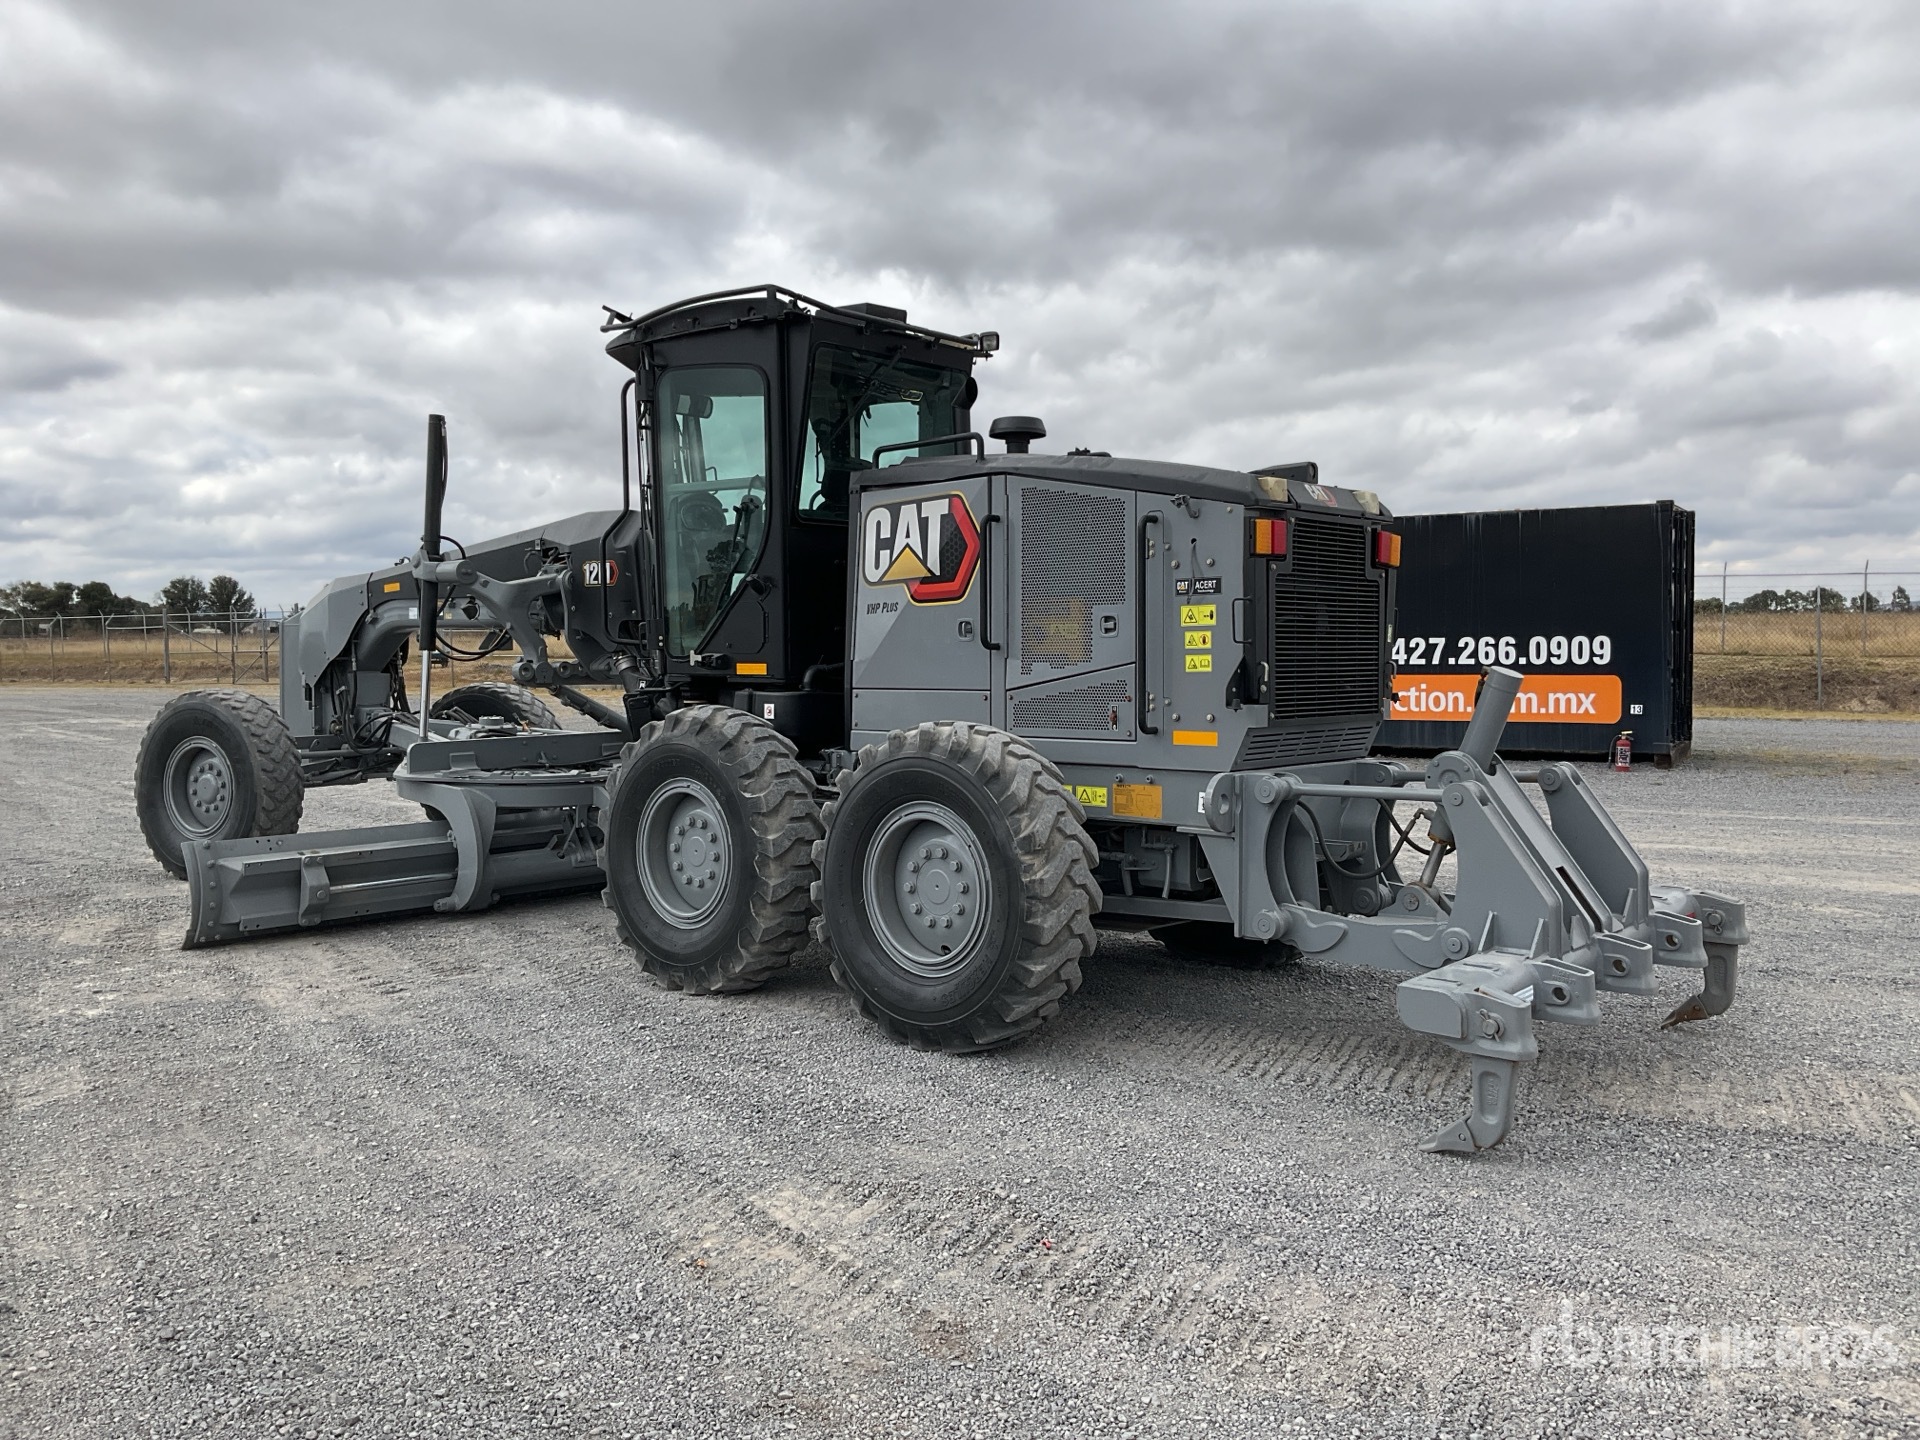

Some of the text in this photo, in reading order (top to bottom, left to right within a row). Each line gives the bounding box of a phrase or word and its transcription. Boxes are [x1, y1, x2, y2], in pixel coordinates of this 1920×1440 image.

[865, 498, 950, 583] CAT
[1176, 581, 1189, 591] CAT
[1195, 580, 1217, 589] ACERT
[867, 603, 881, 615] VHP
[1391, 635, 1611, 665] 427.266.0909
[1632, 705, 1642, 714] 13
